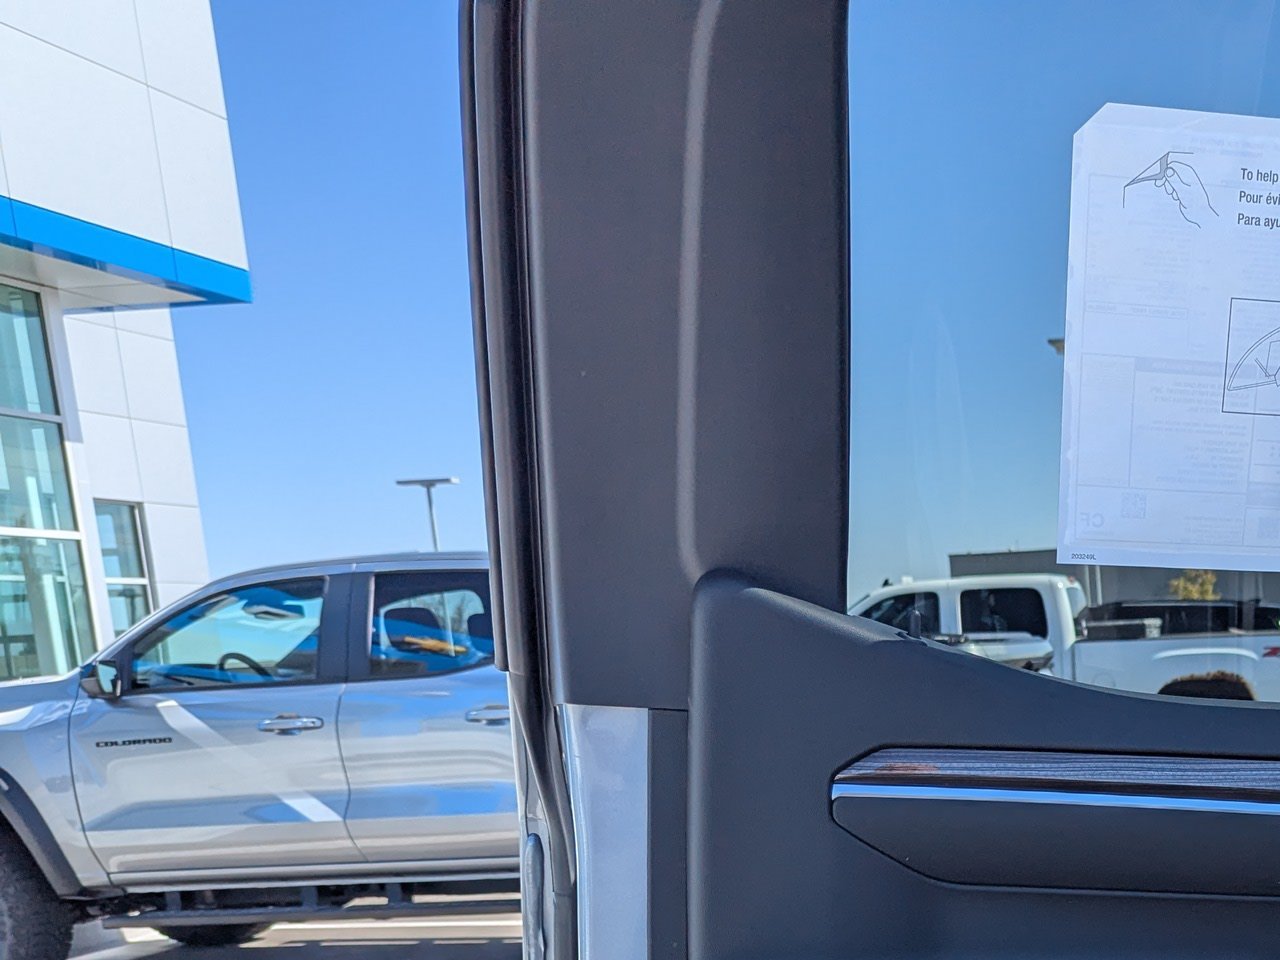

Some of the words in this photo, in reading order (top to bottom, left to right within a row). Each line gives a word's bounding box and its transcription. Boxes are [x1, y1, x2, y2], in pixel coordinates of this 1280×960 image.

[1240, 167, 1254, 181] To
[1256, 168, 1279, 185] help
[1238, 190, 1264, 204] Pour
[1237, 212, 1261, 226] Para
[95, 737, 173, 748] COLORADO
